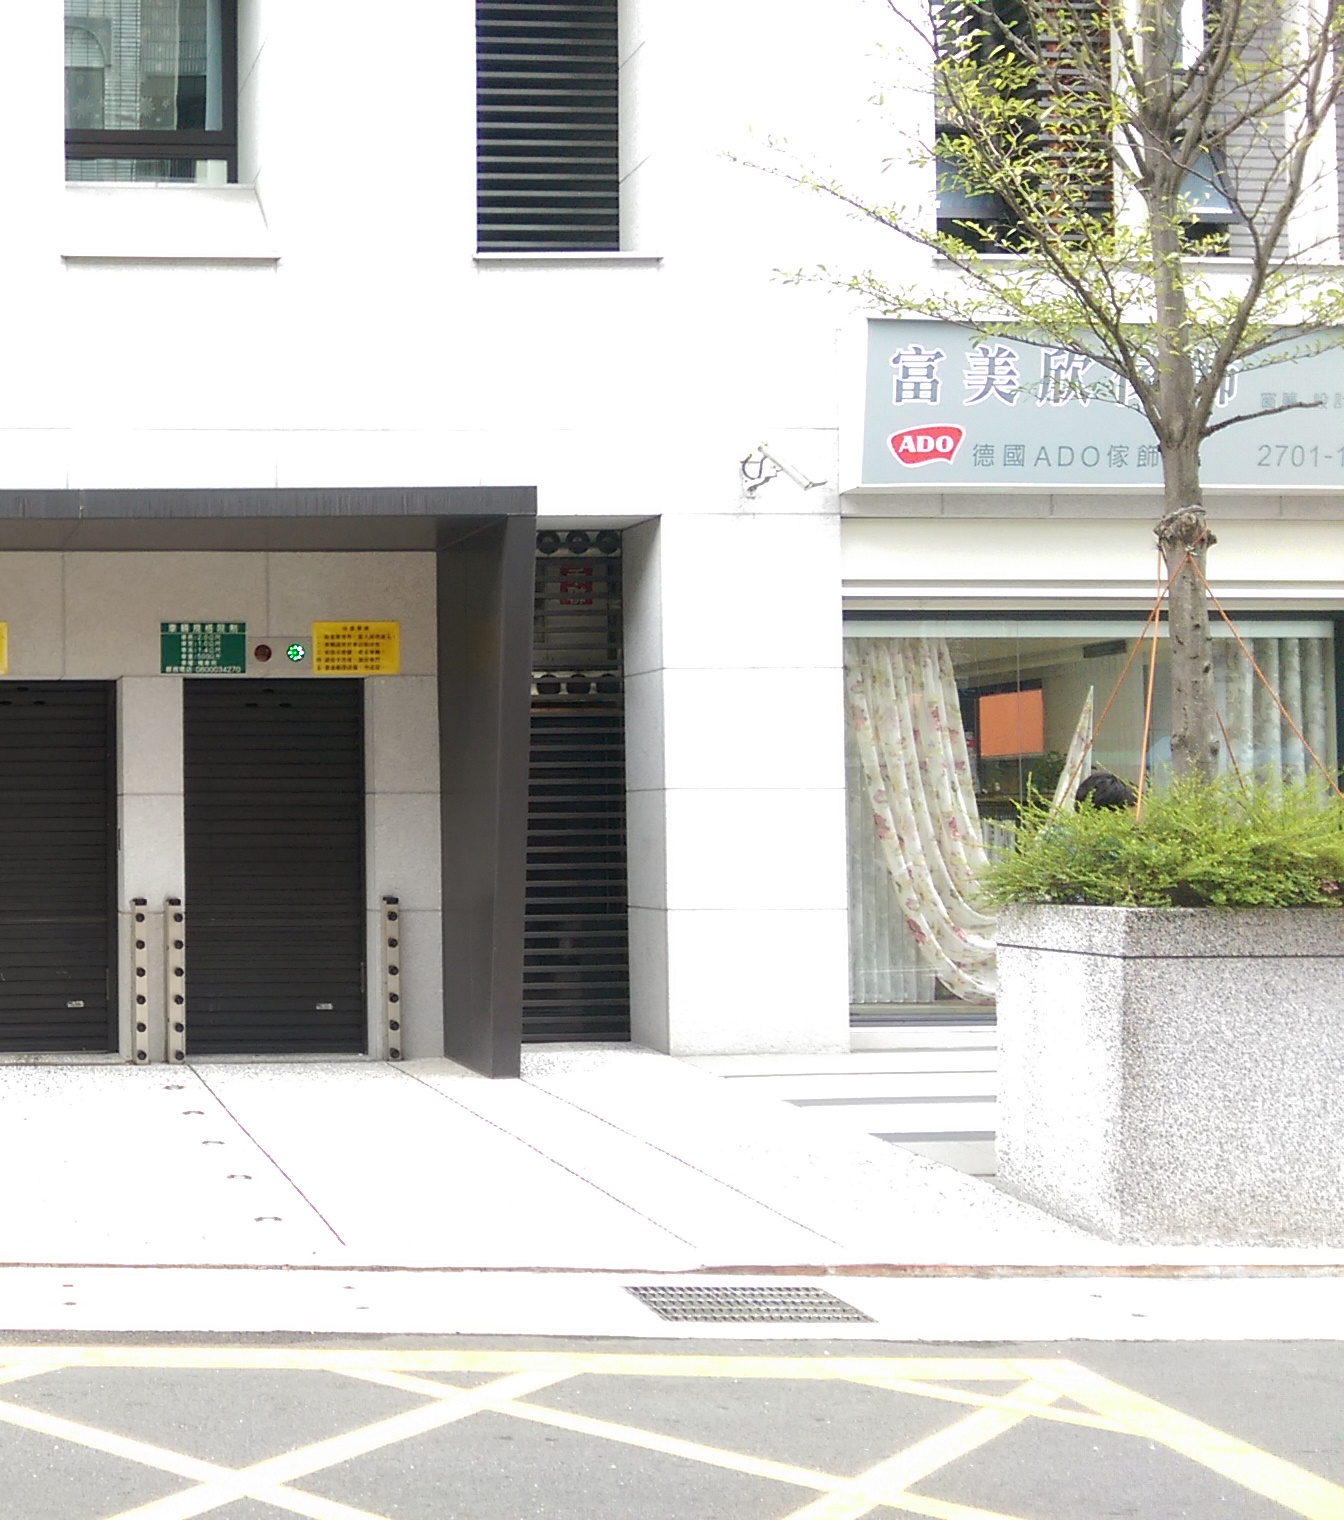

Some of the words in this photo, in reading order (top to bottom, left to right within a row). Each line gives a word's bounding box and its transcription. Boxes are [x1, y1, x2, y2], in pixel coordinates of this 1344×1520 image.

[898, 435, 954, 453] ADO
[972, 443, 1159, 468] 德國ADO傢飾
